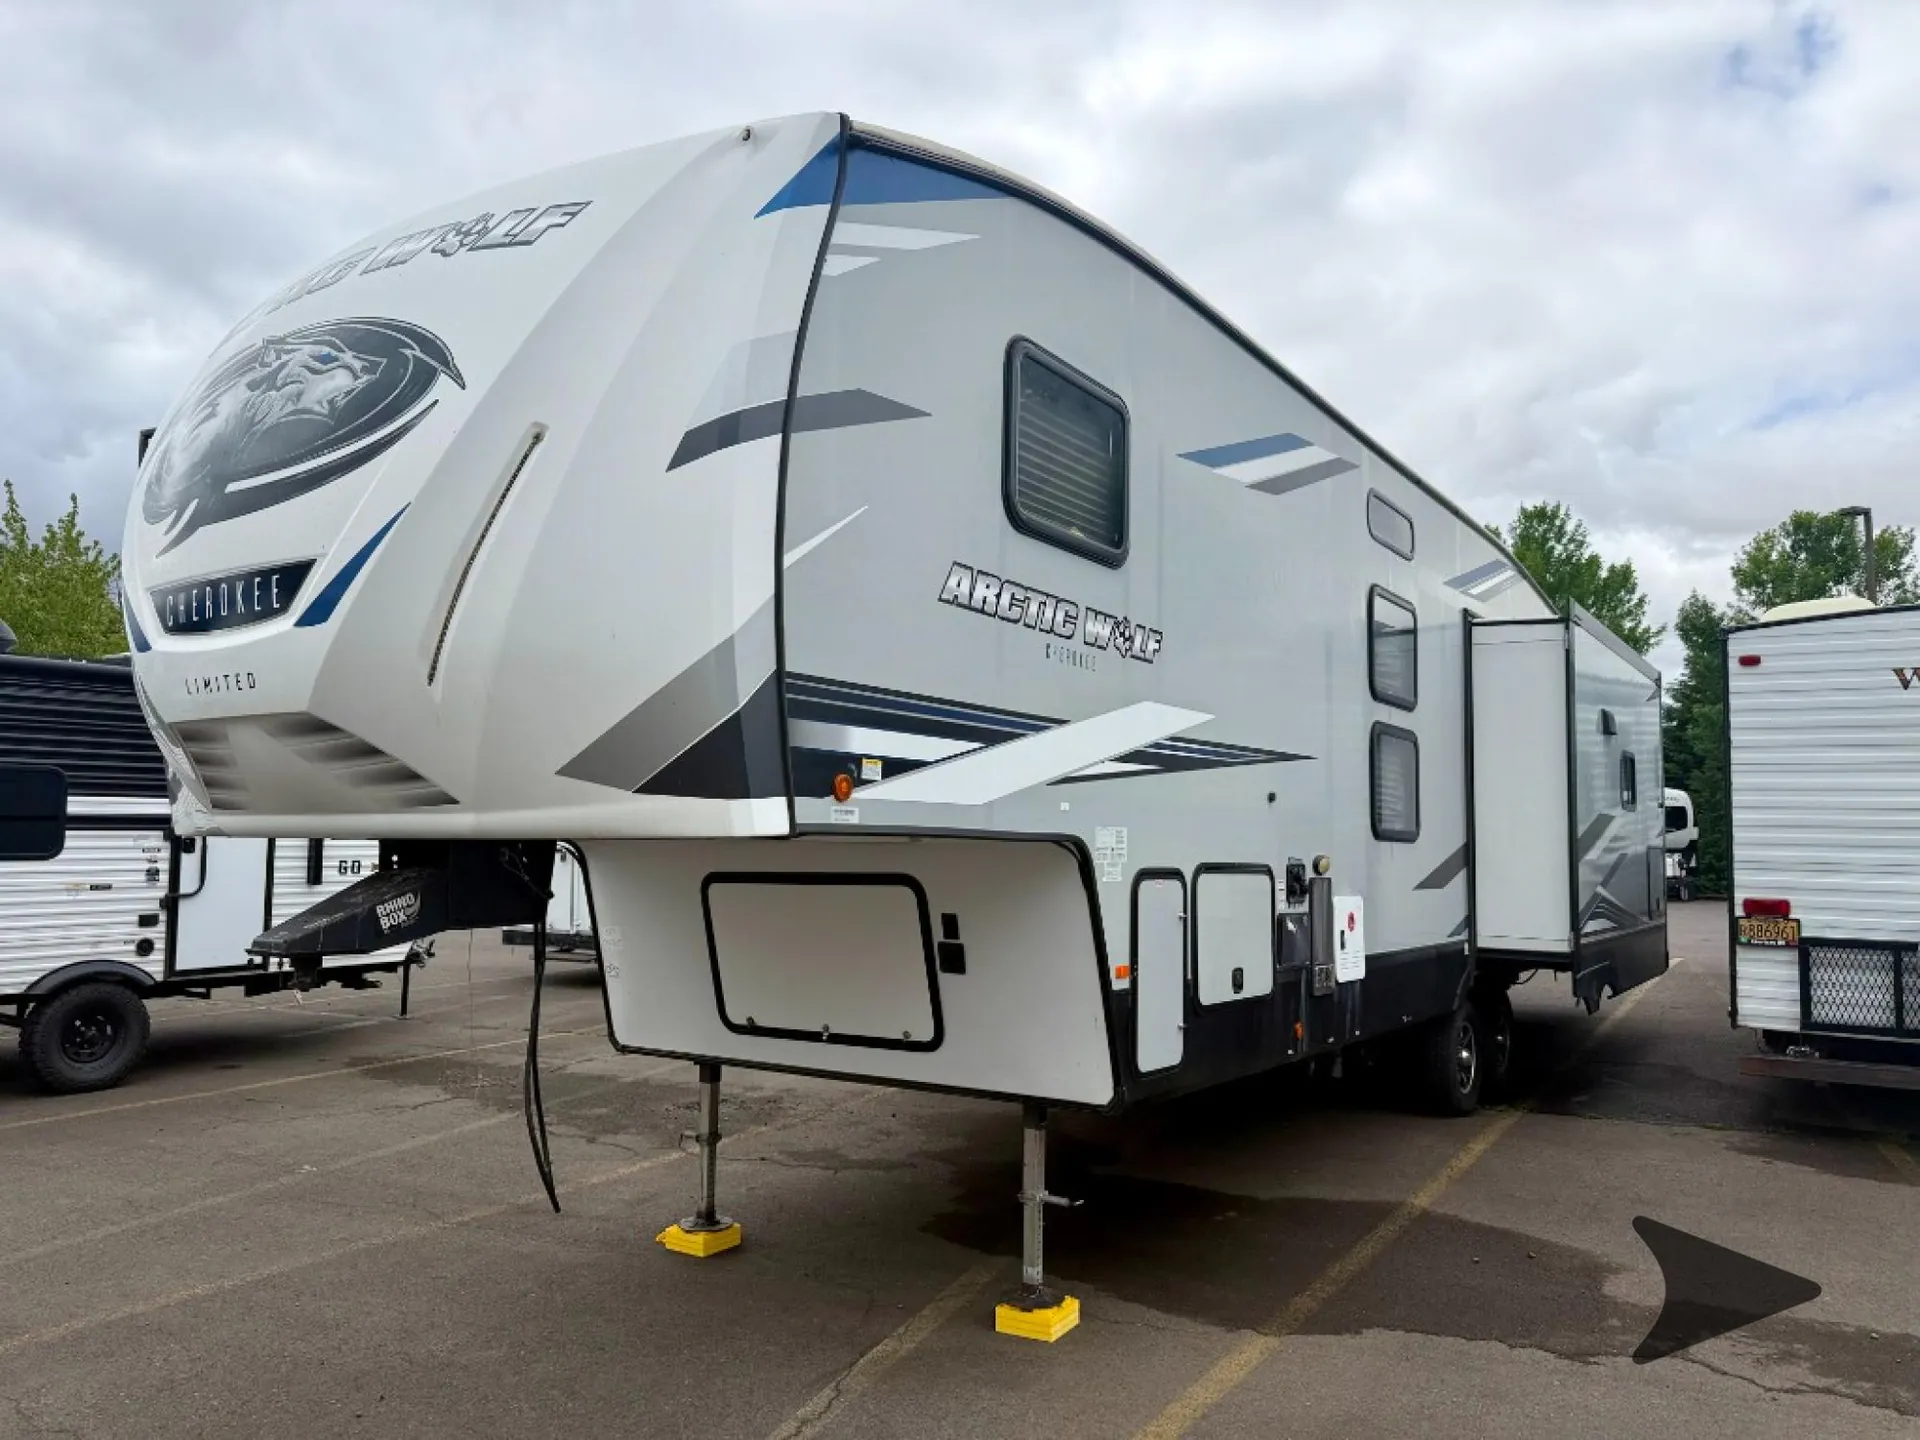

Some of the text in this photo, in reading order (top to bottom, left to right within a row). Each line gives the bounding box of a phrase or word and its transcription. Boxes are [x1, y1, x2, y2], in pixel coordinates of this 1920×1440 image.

[166, 574, 281, 627] CHEROKEE
[937, 560, 1079, 640] ARCTIC
[185, 671, 257, 696] LIMITED
[338, 860, 361, 876] GO
[376, 892, 415, 917] RHINO
[380, 909, 408, 930] BOX
